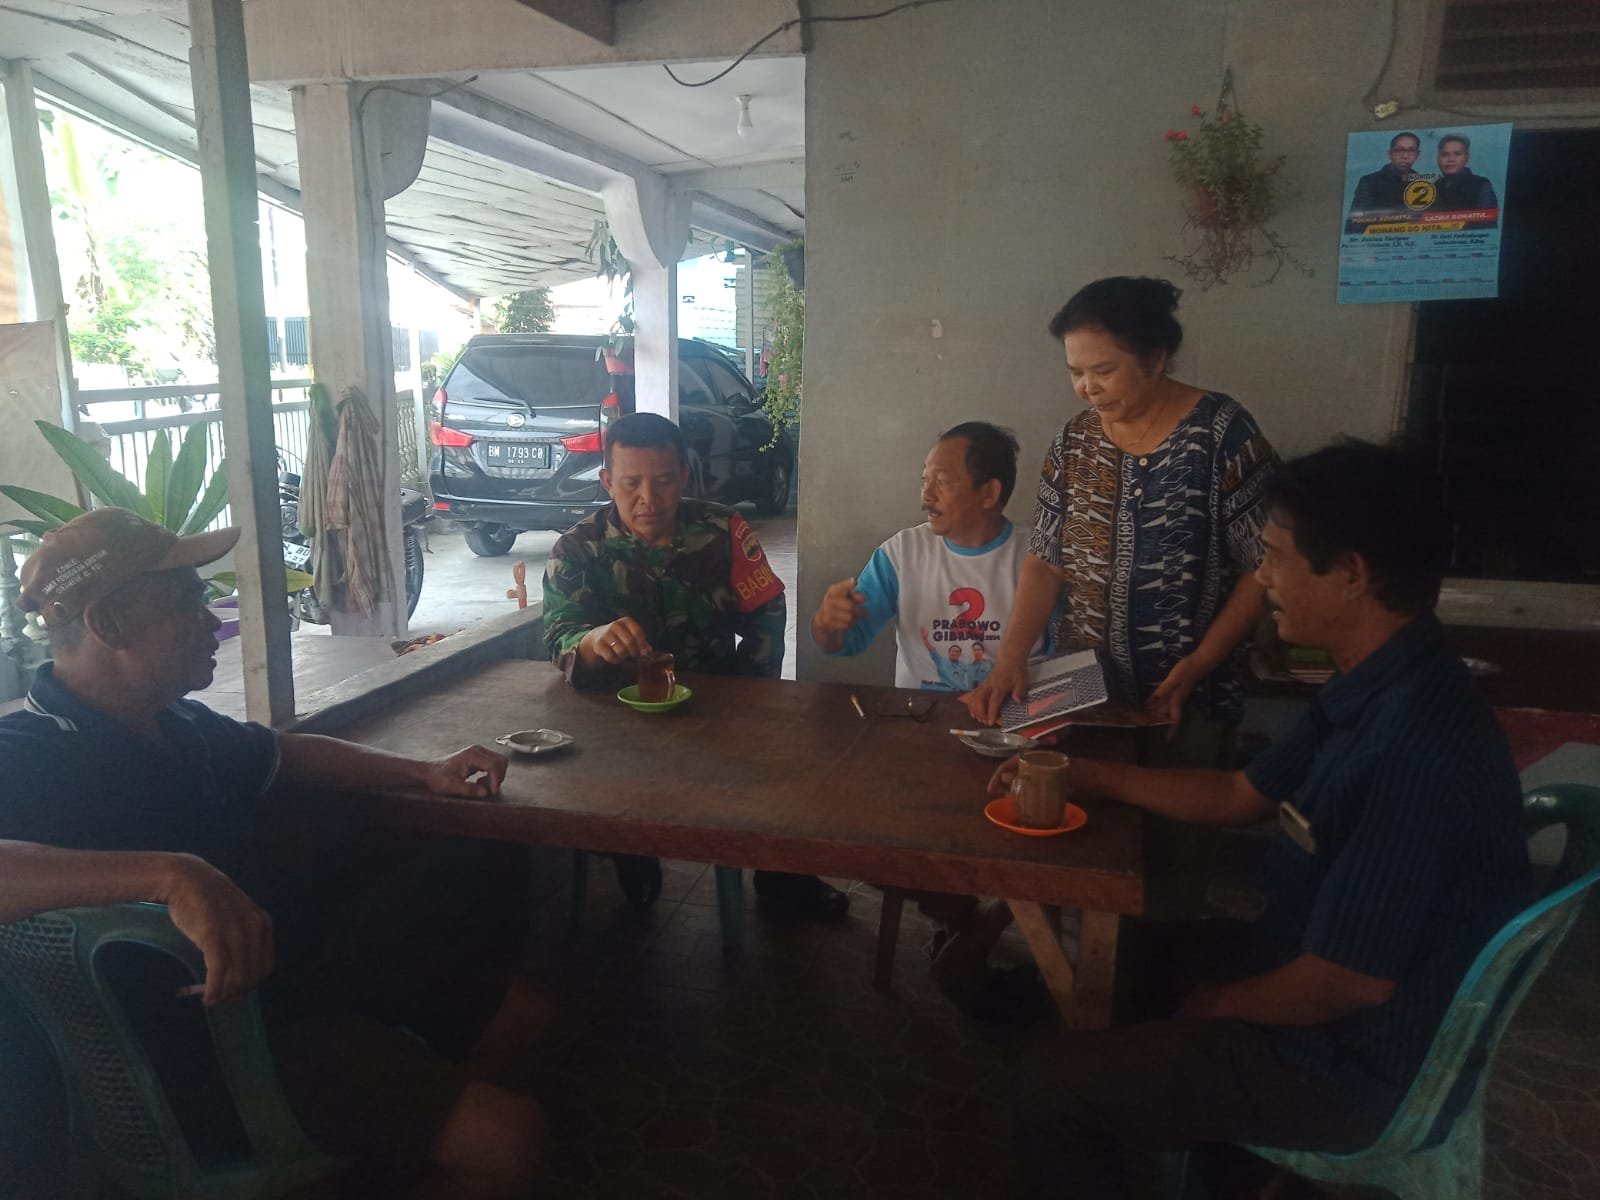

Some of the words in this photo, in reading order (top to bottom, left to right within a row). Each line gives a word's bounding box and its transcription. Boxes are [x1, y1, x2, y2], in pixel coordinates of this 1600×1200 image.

[1411, 186, 1429, 206] 2
[488, 445, 500, 457] BM
[507, 446, 529, 459] 1793
[949, 588, 985, 637] 2
[932, 619, 1001, 632] PRABOWO
[932, 631, 985, 642] GIBRAN
